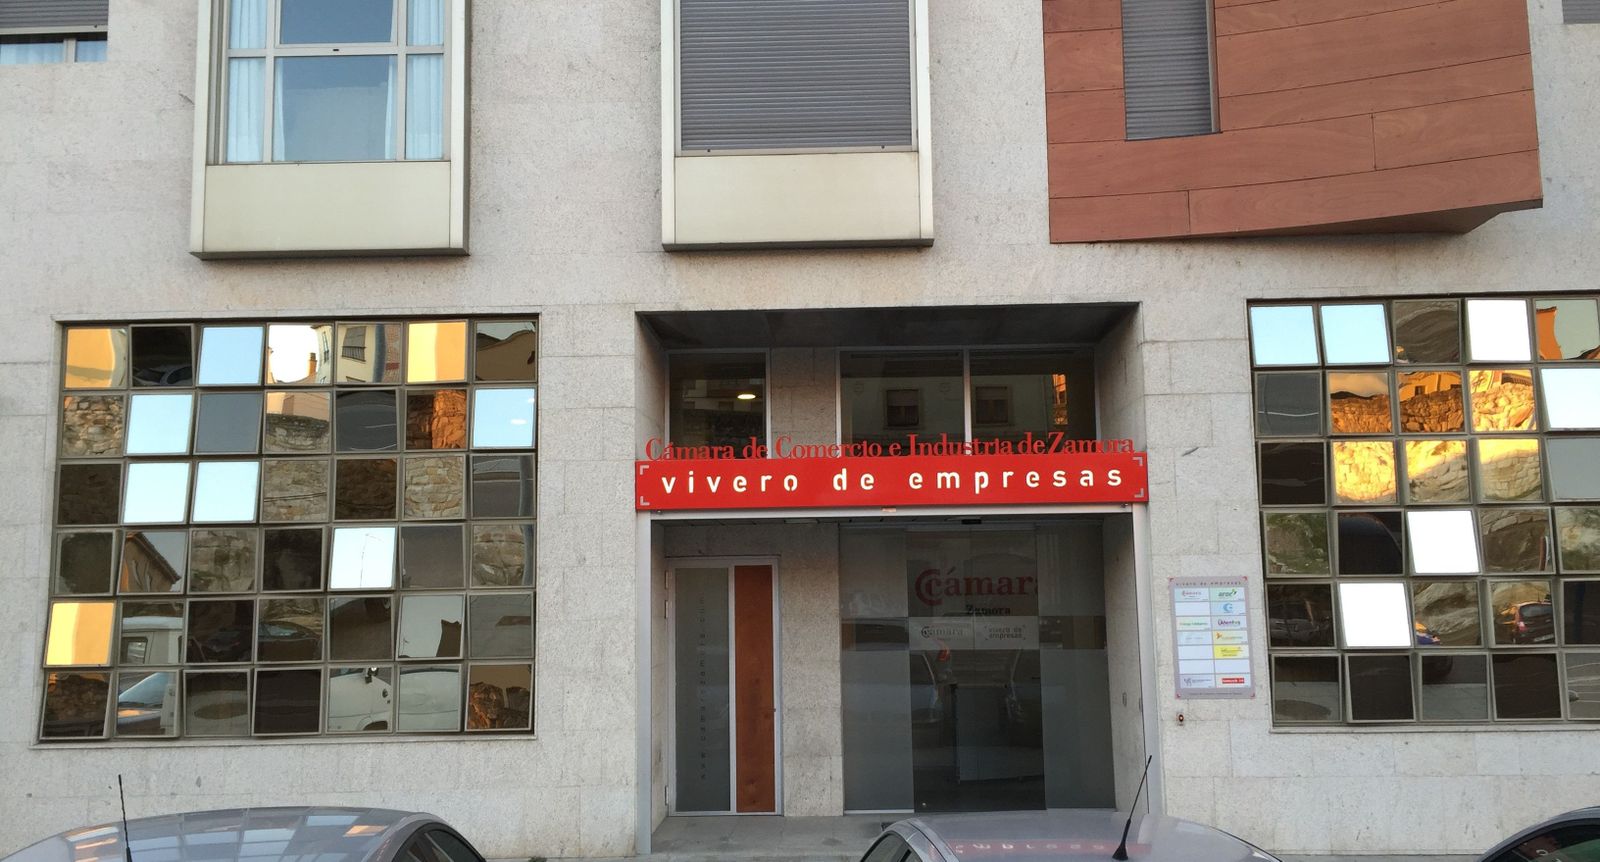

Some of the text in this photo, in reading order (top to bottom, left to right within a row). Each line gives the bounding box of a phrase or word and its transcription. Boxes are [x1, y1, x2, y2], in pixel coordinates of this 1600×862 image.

[645, 437, 736, 461] Cámara
[742, 436, 769, 459] de
[775, 435, 882, 459] Comercio
[888, 441, 901, 457] e
[906, 433, 1013, 456] Industria
[1048, 431, 1136, 454] Zamora
[661, 468, 1123, 495] vivero de empresas
